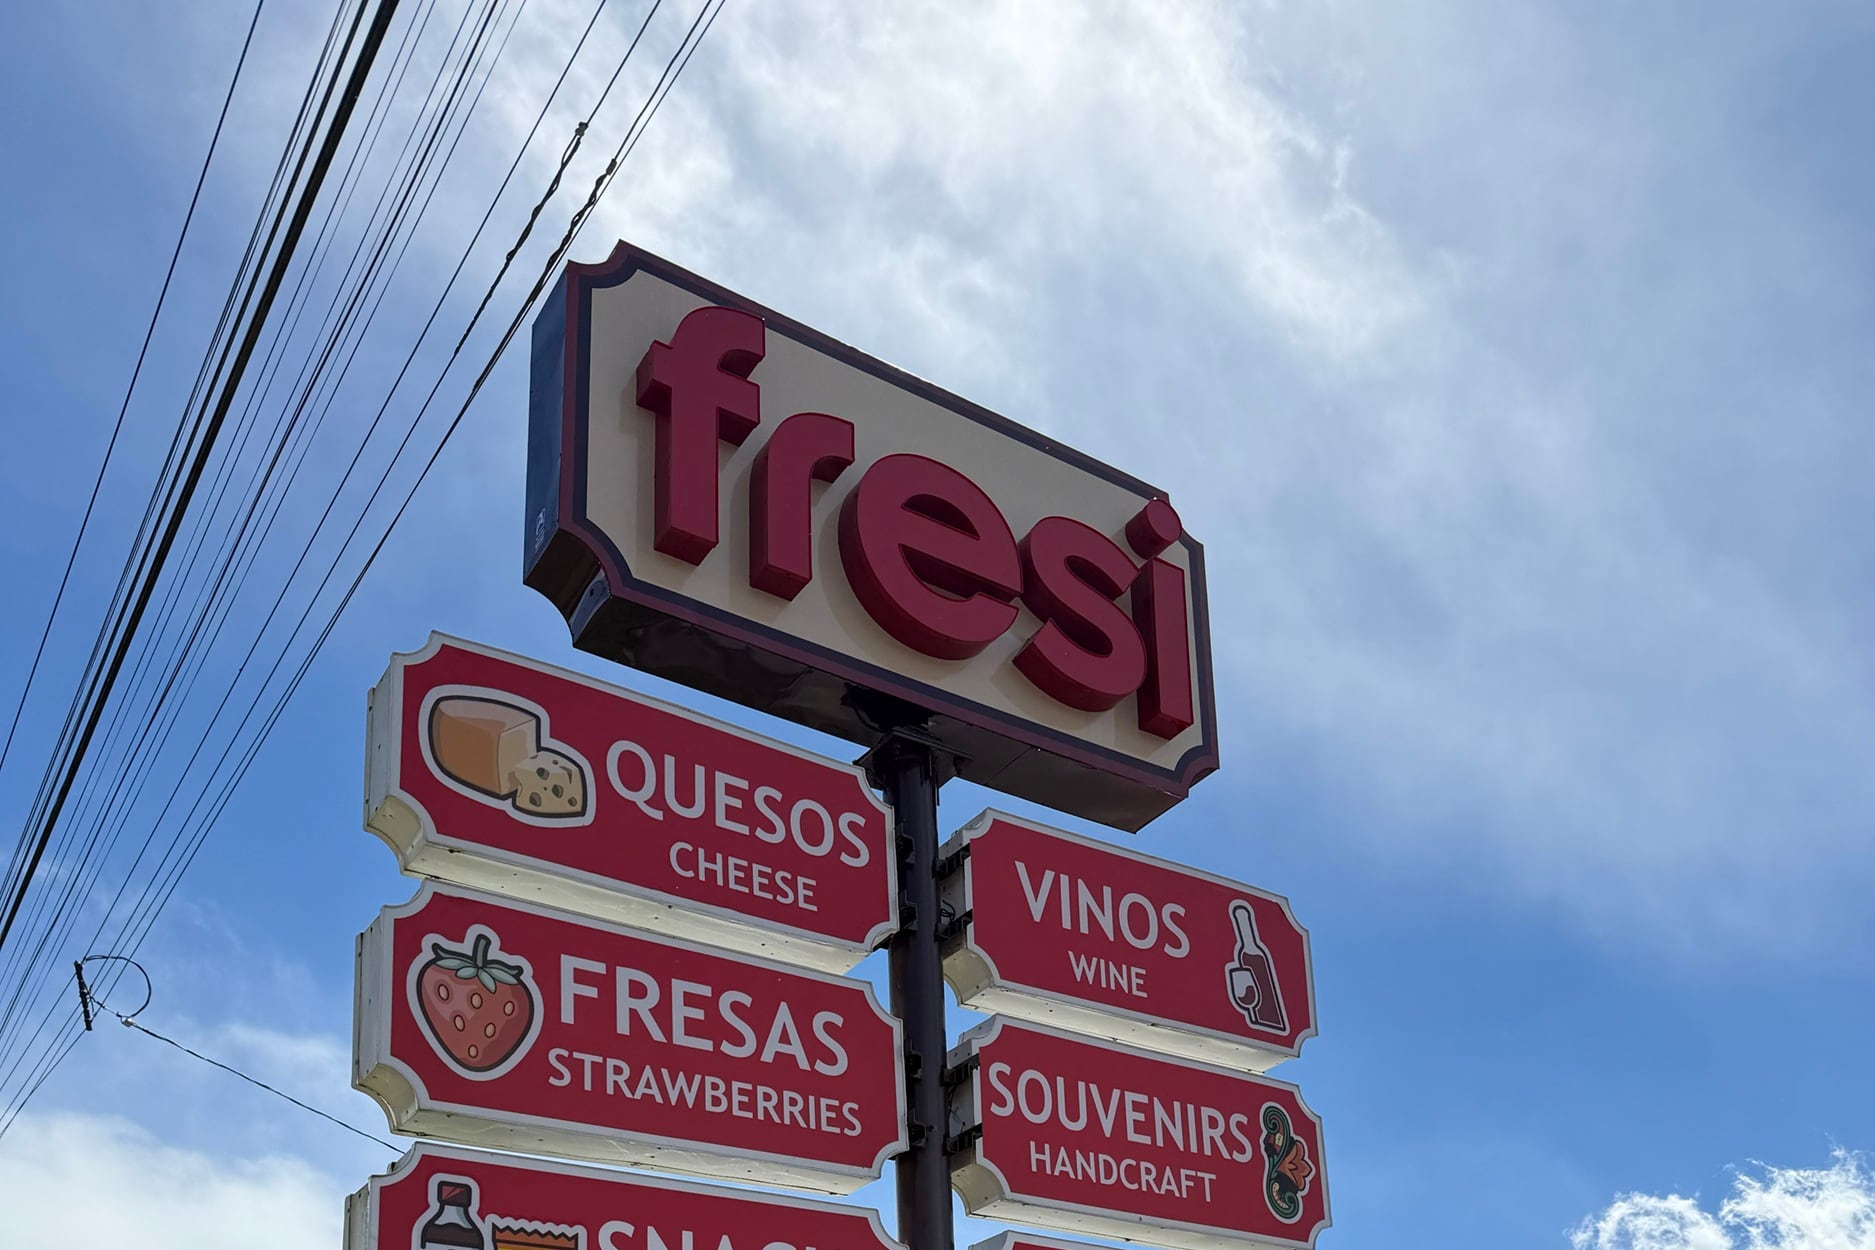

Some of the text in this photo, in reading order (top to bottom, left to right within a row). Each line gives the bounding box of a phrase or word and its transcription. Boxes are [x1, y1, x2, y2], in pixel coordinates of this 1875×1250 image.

[636, 306, 1193, 740] fresi
[606, 739, 870, 868] QUESOS
[669, 841, 819, 912] CHEESE
[1014, 860, 1190, 959] VINOS
[559, 953, 849, 1077] FRESAS
[1067, 950, 1149, 999] WINE
[547, 1047, 862, 1137] STRAWBERRIES
[988, 1062, 1253, 1163] SOUVENIRS
[1029, 1140, 1216, 1202] HANDCRAFT
